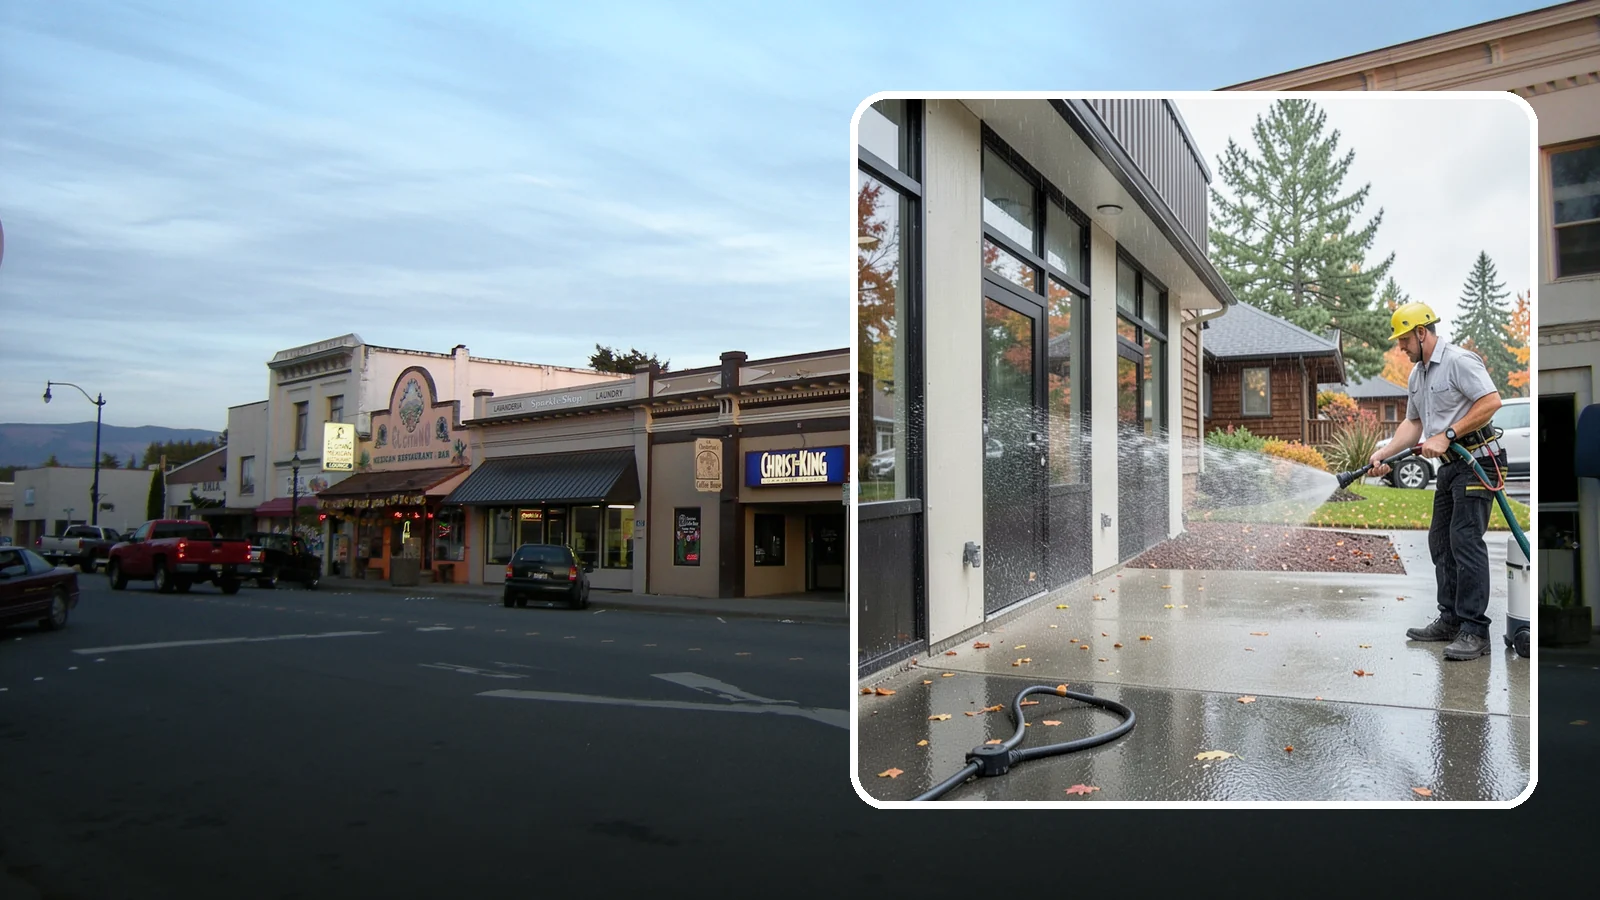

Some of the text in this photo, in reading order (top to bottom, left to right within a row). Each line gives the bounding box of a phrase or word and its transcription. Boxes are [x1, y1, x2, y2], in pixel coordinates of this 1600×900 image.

[531, 394, 583, 408] Sparkle Shop
[596, 389, 624, 400] LAUNDRY
[493, 402, 522, 412] LAVANDERIA
[373, 454, 396, 464] MEXICAN
[397, 451, 433, 463] RESTAURANT
[438, 450, 450, 459] BAR
[760, 450, 827, 478] CHRIST KING
